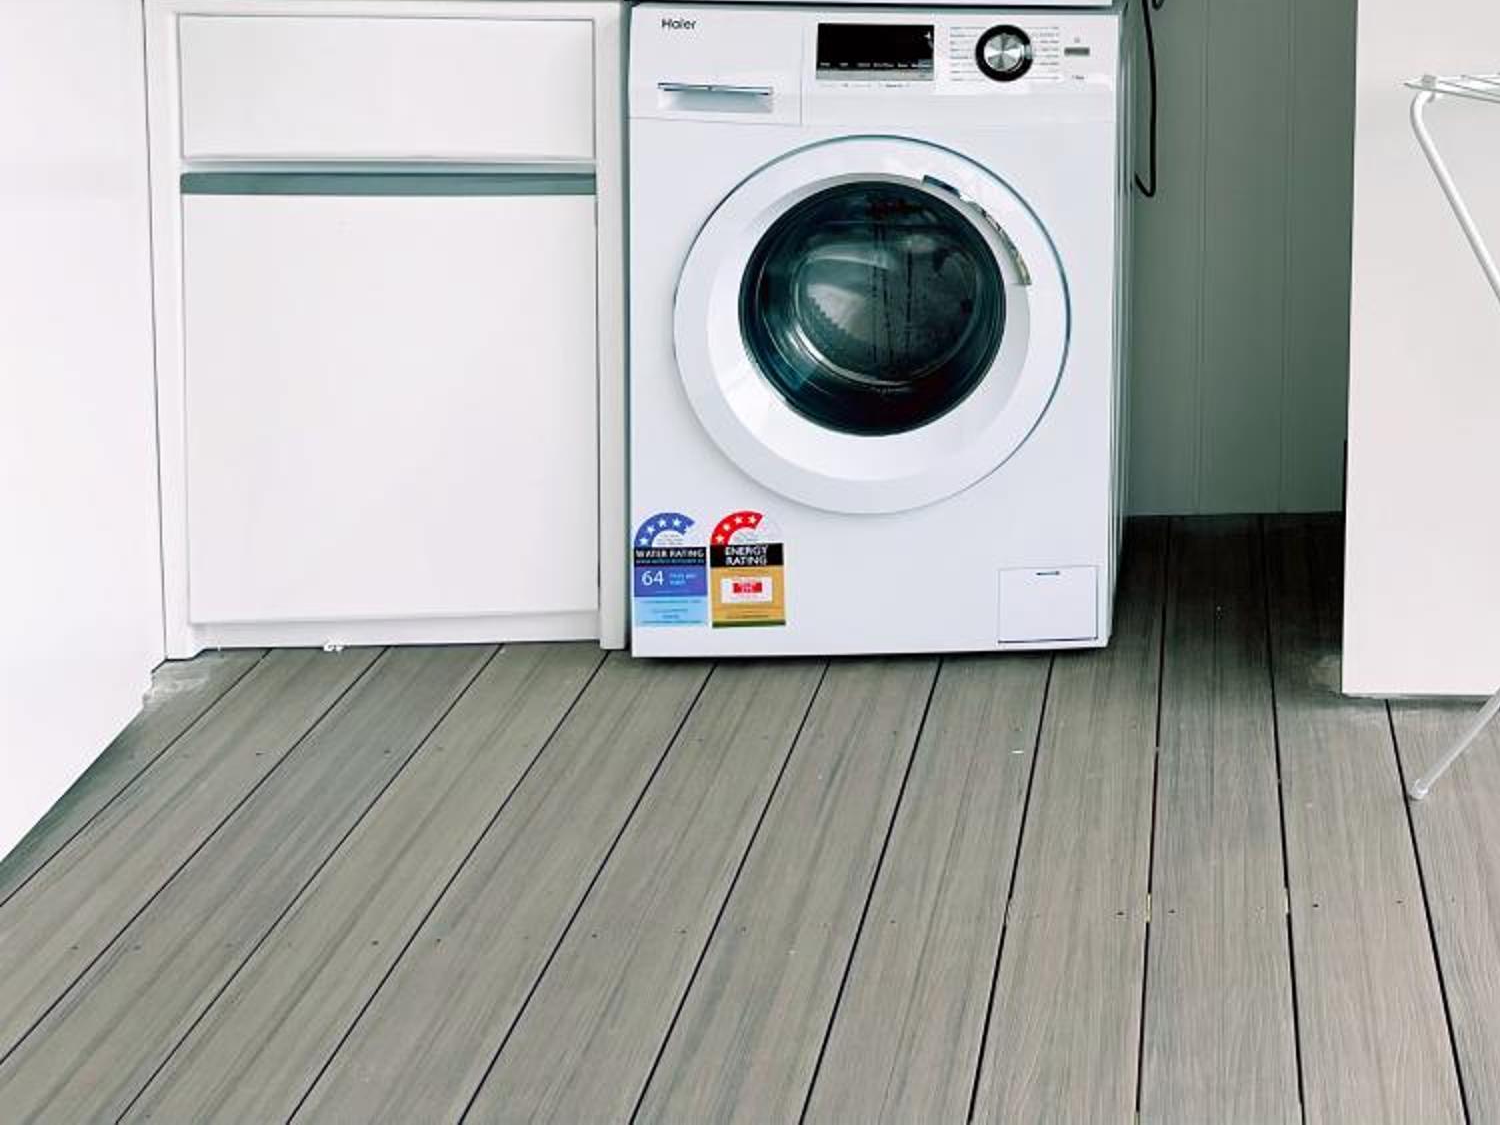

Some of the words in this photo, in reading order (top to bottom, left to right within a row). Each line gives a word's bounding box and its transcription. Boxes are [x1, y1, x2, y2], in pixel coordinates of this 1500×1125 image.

[661, 18, 697, 30] Haier
[635, 549, 668, 558] WATER
[669, 549, 705, 558] RATING
[725, 546, 769, 556] ENERGY
[725, 556, 768, 566] RATING
[641, 570, 665, 586] 64
